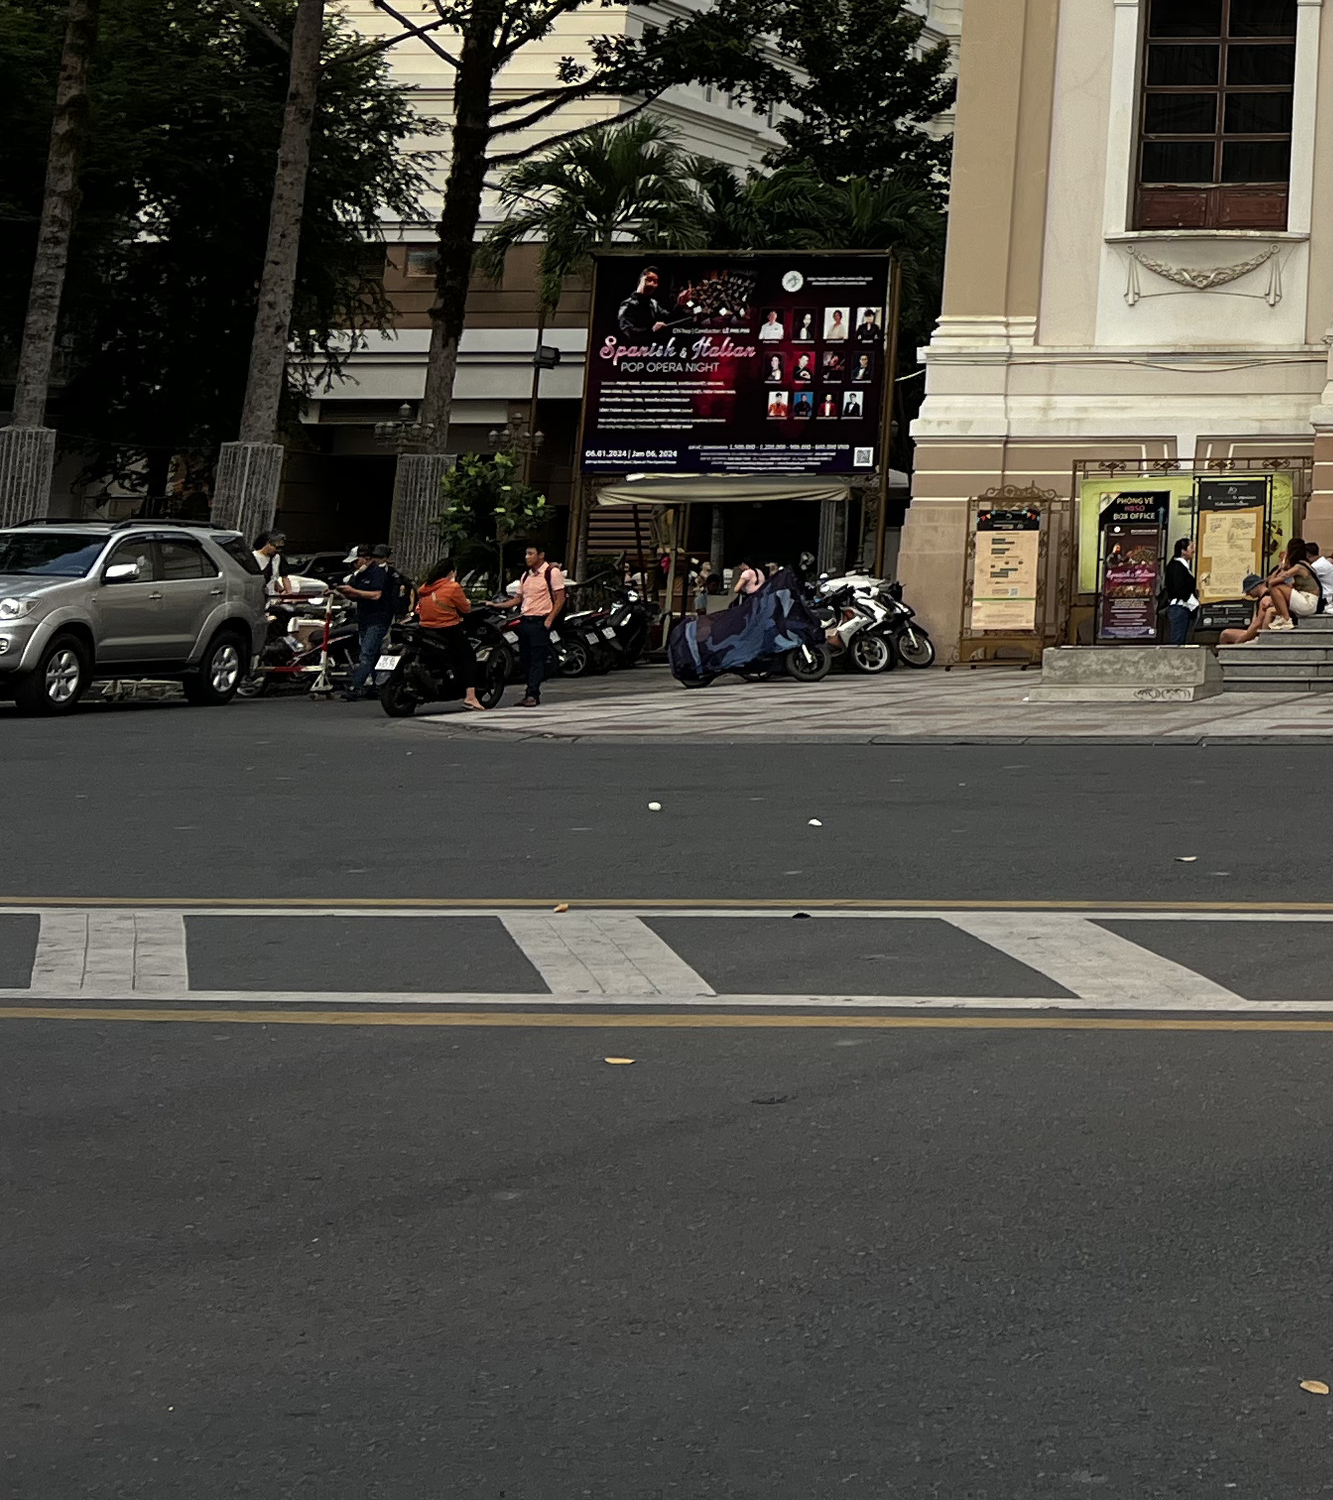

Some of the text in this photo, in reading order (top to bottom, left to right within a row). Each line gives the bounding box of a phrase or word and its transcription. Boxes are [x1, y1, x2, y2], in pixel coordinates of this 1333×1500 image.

[600, 335, 757, 366] Spanish & Italian
[620, 361, 720, 373] POP OPERA NIGHT
